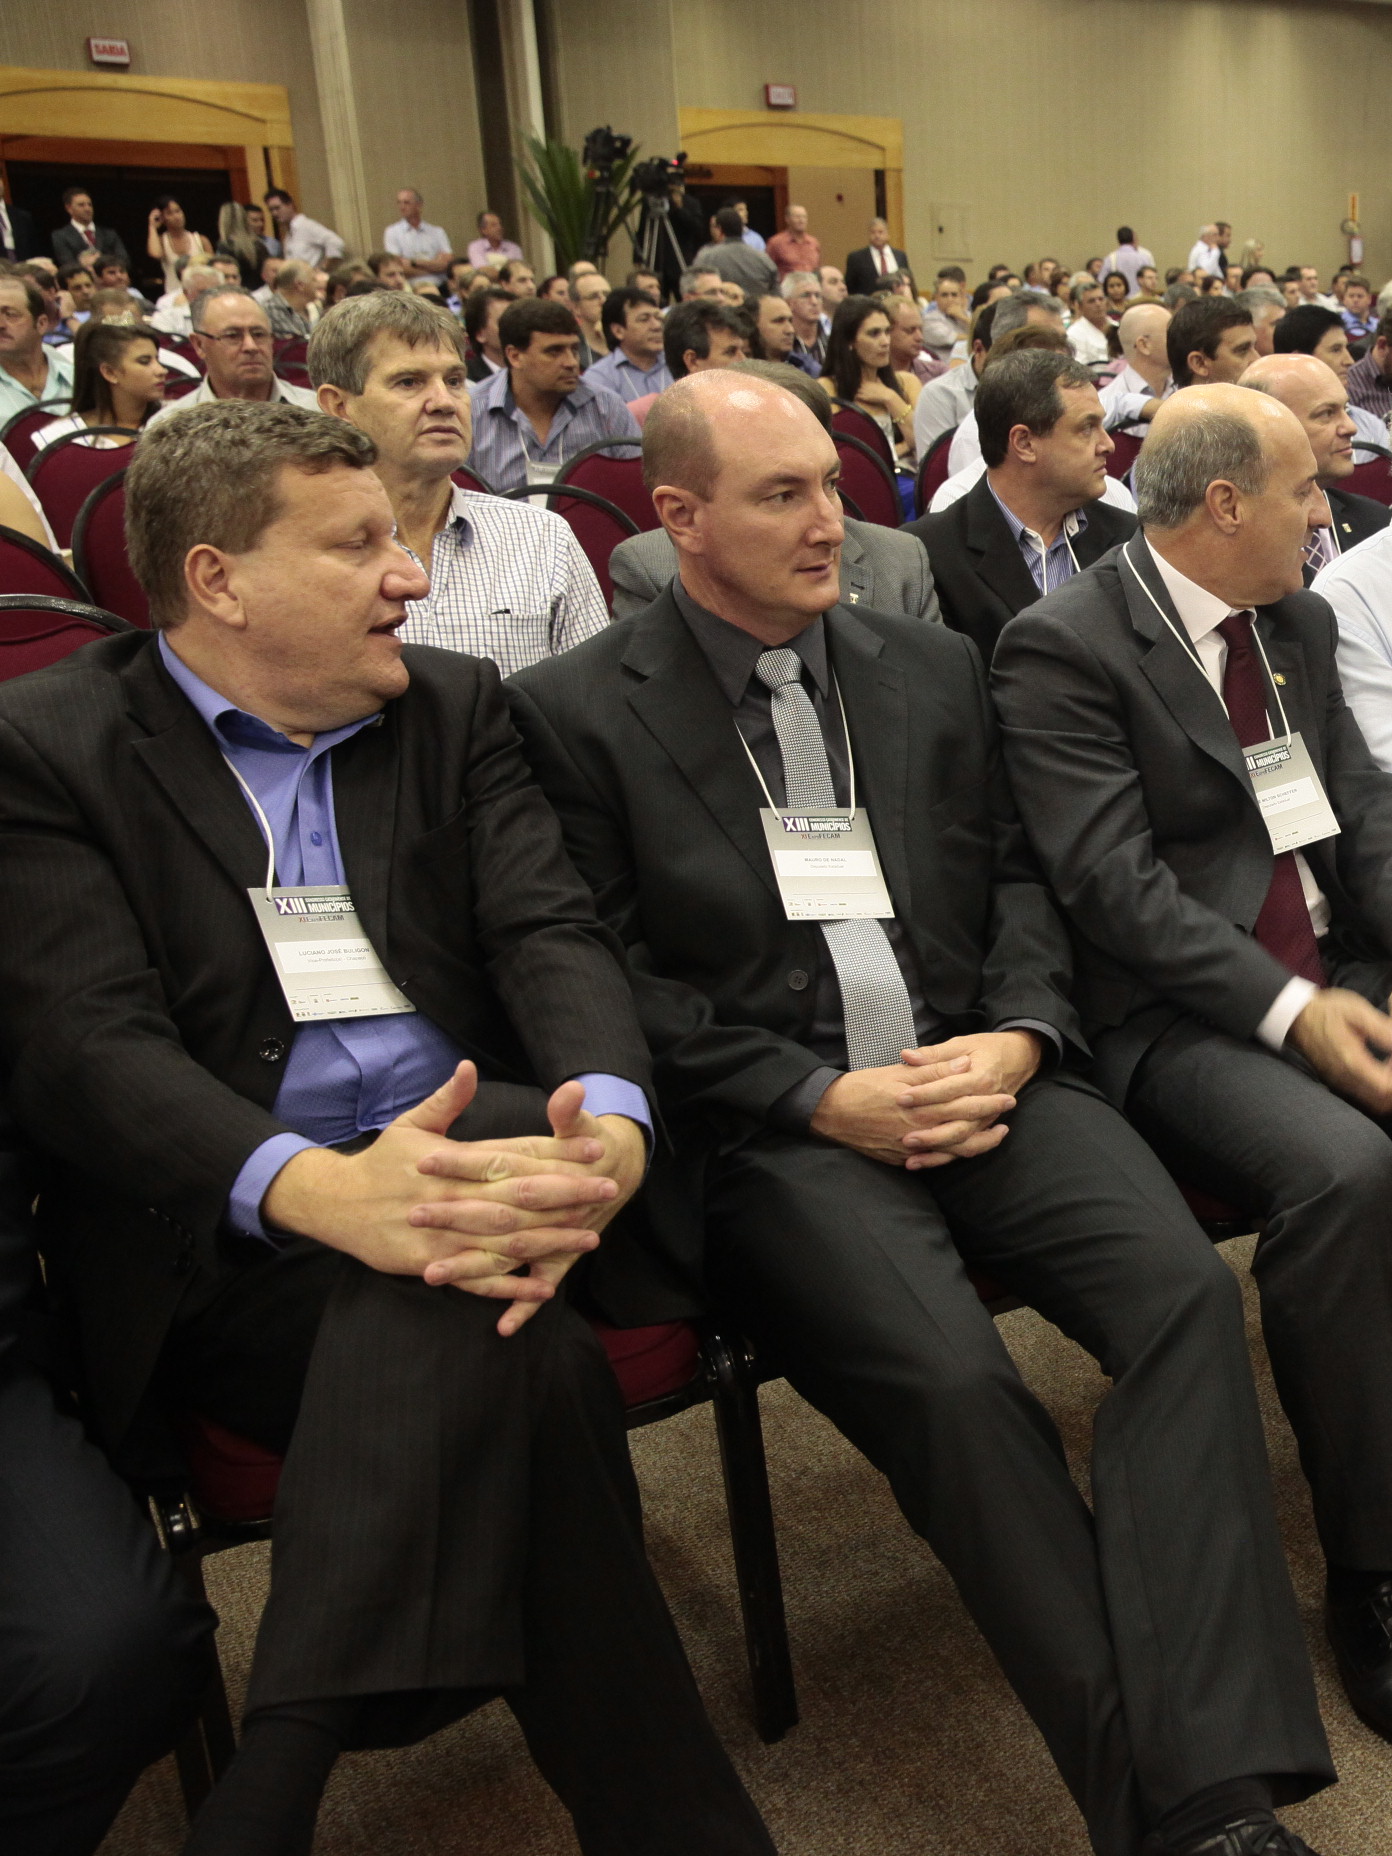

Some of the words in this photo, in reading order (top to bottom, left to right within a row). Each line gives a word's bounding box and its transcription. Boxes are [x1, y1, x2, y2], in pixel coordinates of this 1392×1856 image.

[783, 817, 810, 832] XIII
[810, 821, 852, 832] MUNICÍPIOS
[275, 897, 309, 915] XIII
[308, 900, 355, 913] MUNICÍPIOS
